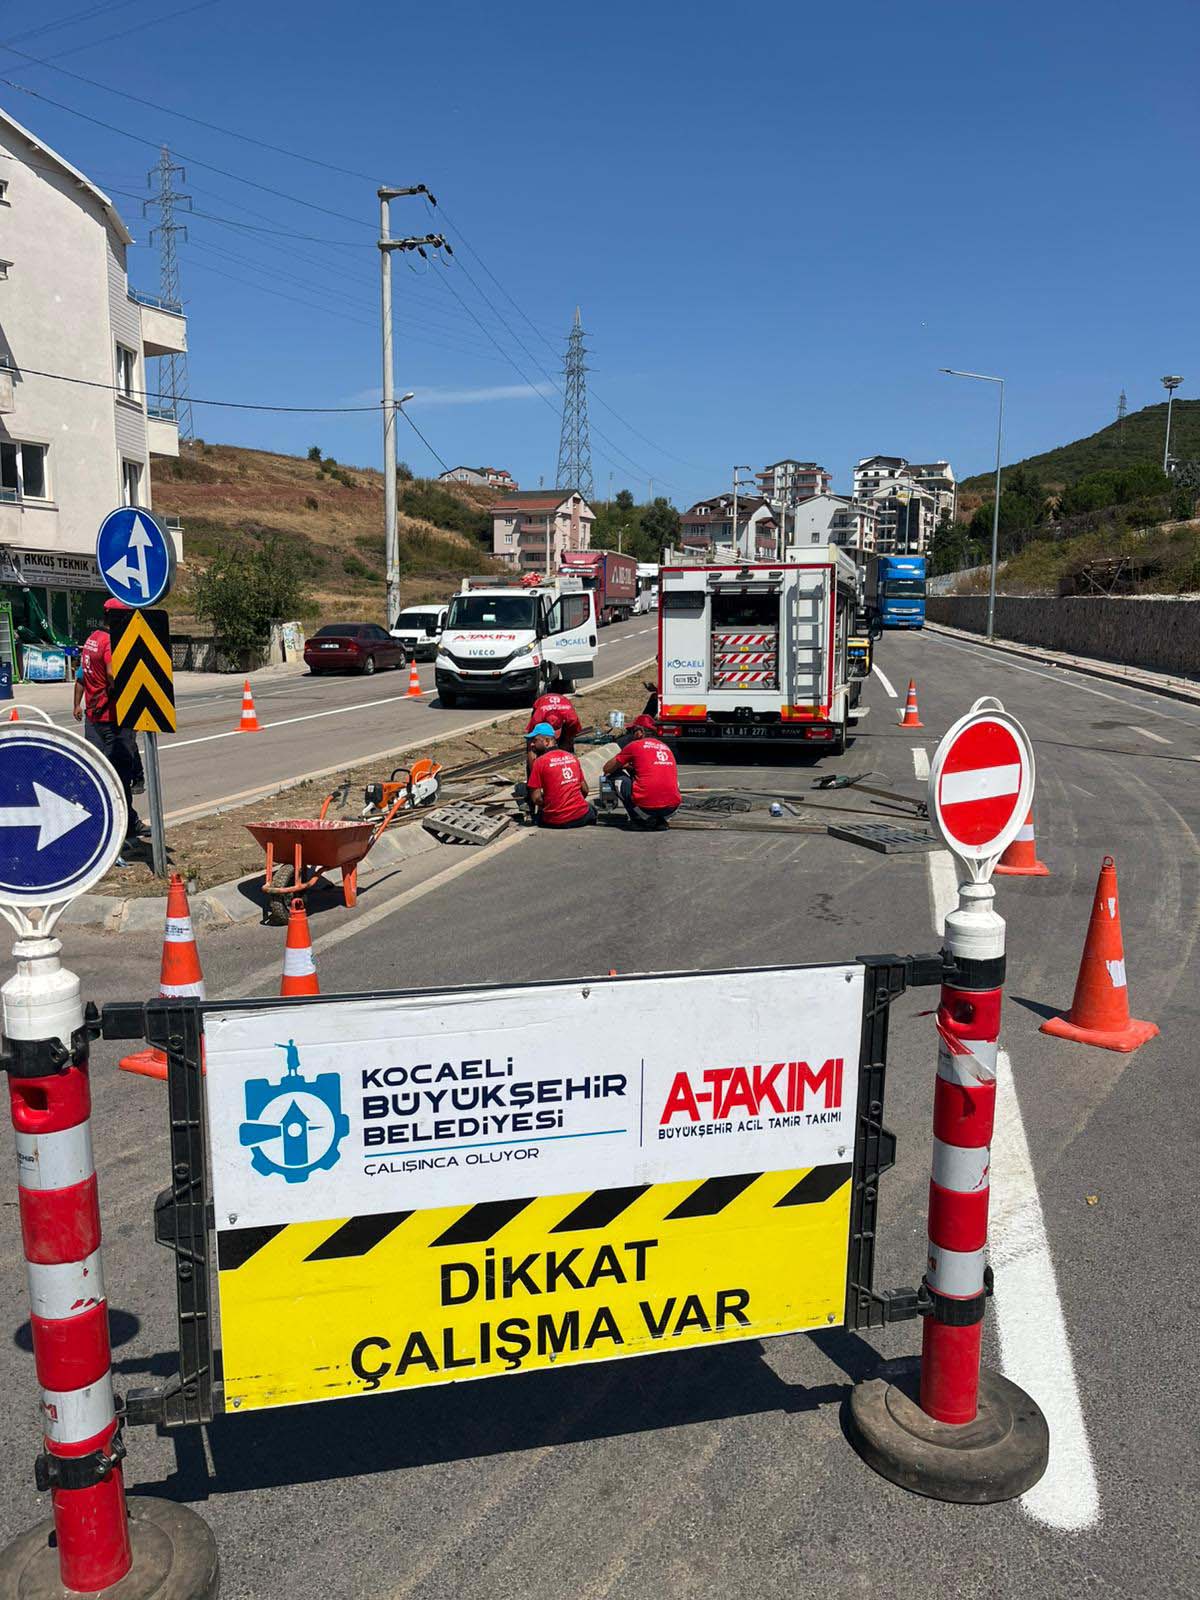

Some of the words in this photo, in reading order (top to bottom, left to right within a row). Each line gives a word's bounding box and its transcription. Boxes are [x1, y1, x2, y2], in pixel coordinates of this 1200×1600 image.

[687, 676, 698, 684] 153
[726, 727, 735, 735] 41
[752, 727, 765, 736] 277
[362, 1056, 513, 1089] KOCAELİ
[362, 1073, 627, 1120] BÜYÜKŞEHİR
[659, 1058, 844, 1125] A-TAKIMI
[363, 1109, 564, 1147] BELEDİYESİ
[658, 1122, 733, 1140] BÜYÜKŞEHİR
[737, 1119, 764, 1133] ACİL
[768, 1115, 801, 1128] TAMİR
[806, 1111, 842, 1125] TAKIMI
[363, 1155, 459, 1177] ÇALIŞINCA
[465, 1147, 539, 1165] OLUYOR
[440, 1238, 658, 1307] DİKKAT
[351, 1306, 626, 1391] ÇALIŞMA
[638, 1288, 751, 1339] VAR
